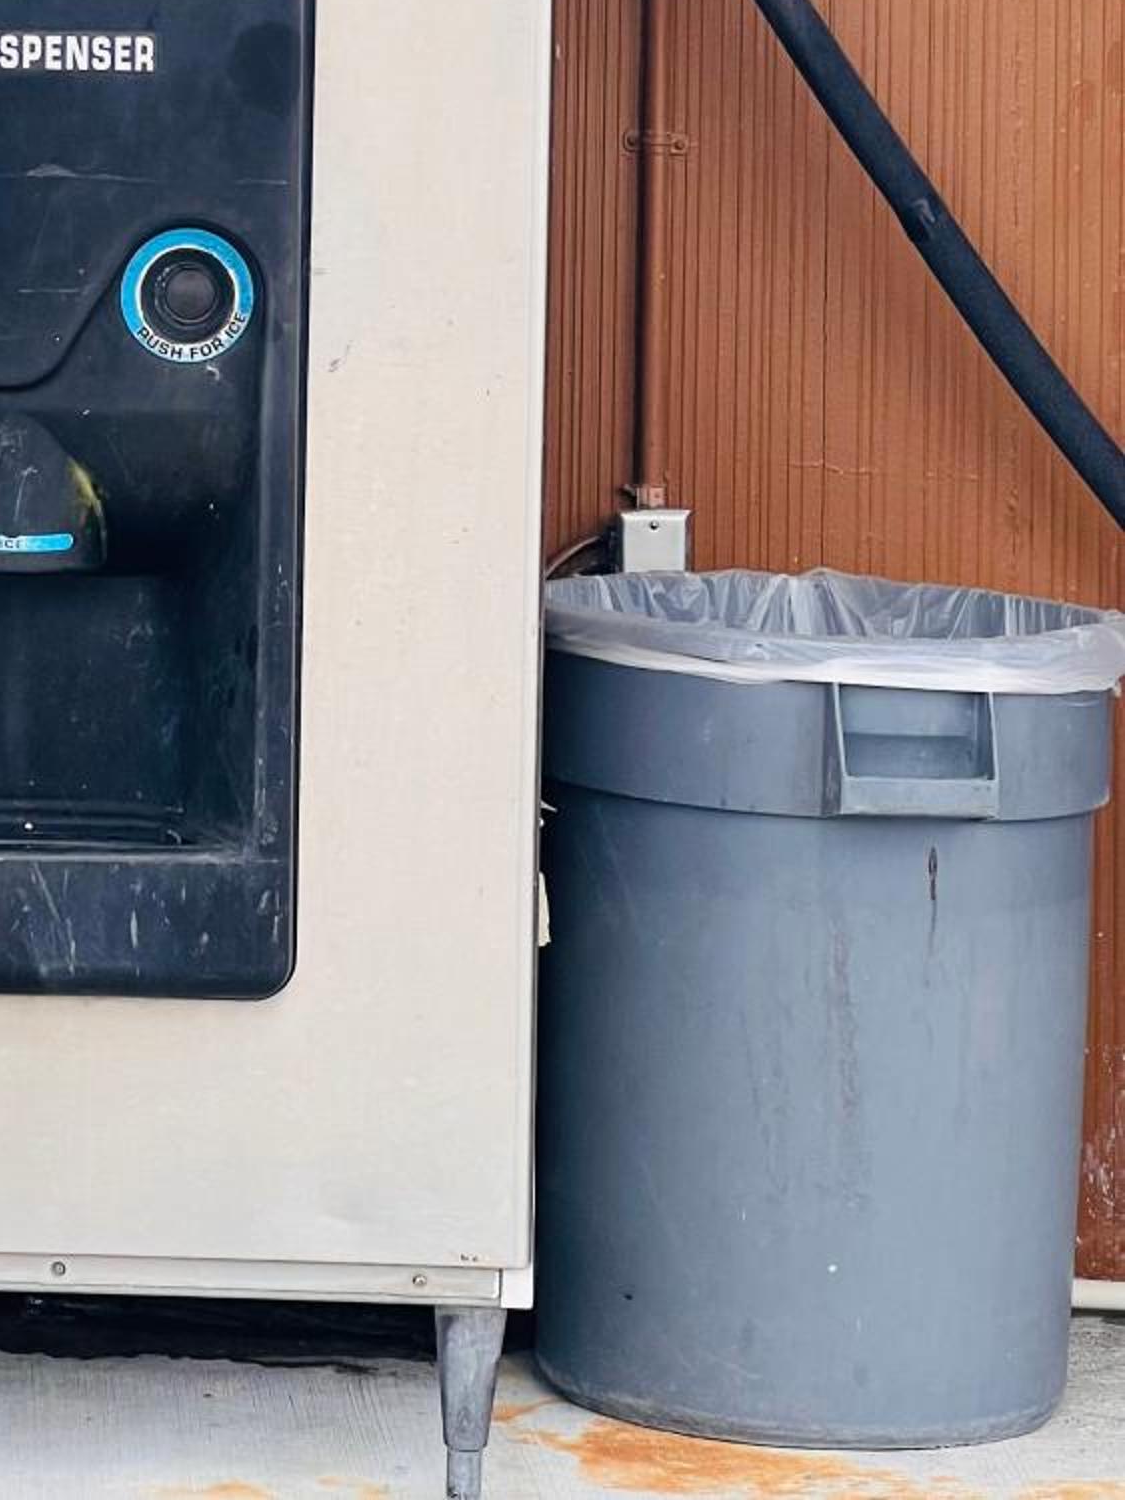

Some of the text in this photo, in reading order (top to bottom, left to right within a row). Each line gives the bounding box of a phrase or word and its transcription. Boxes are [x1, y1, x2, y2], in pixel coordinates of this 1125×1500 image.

[137, 311, 247, 360] PUSH FOR ICE
